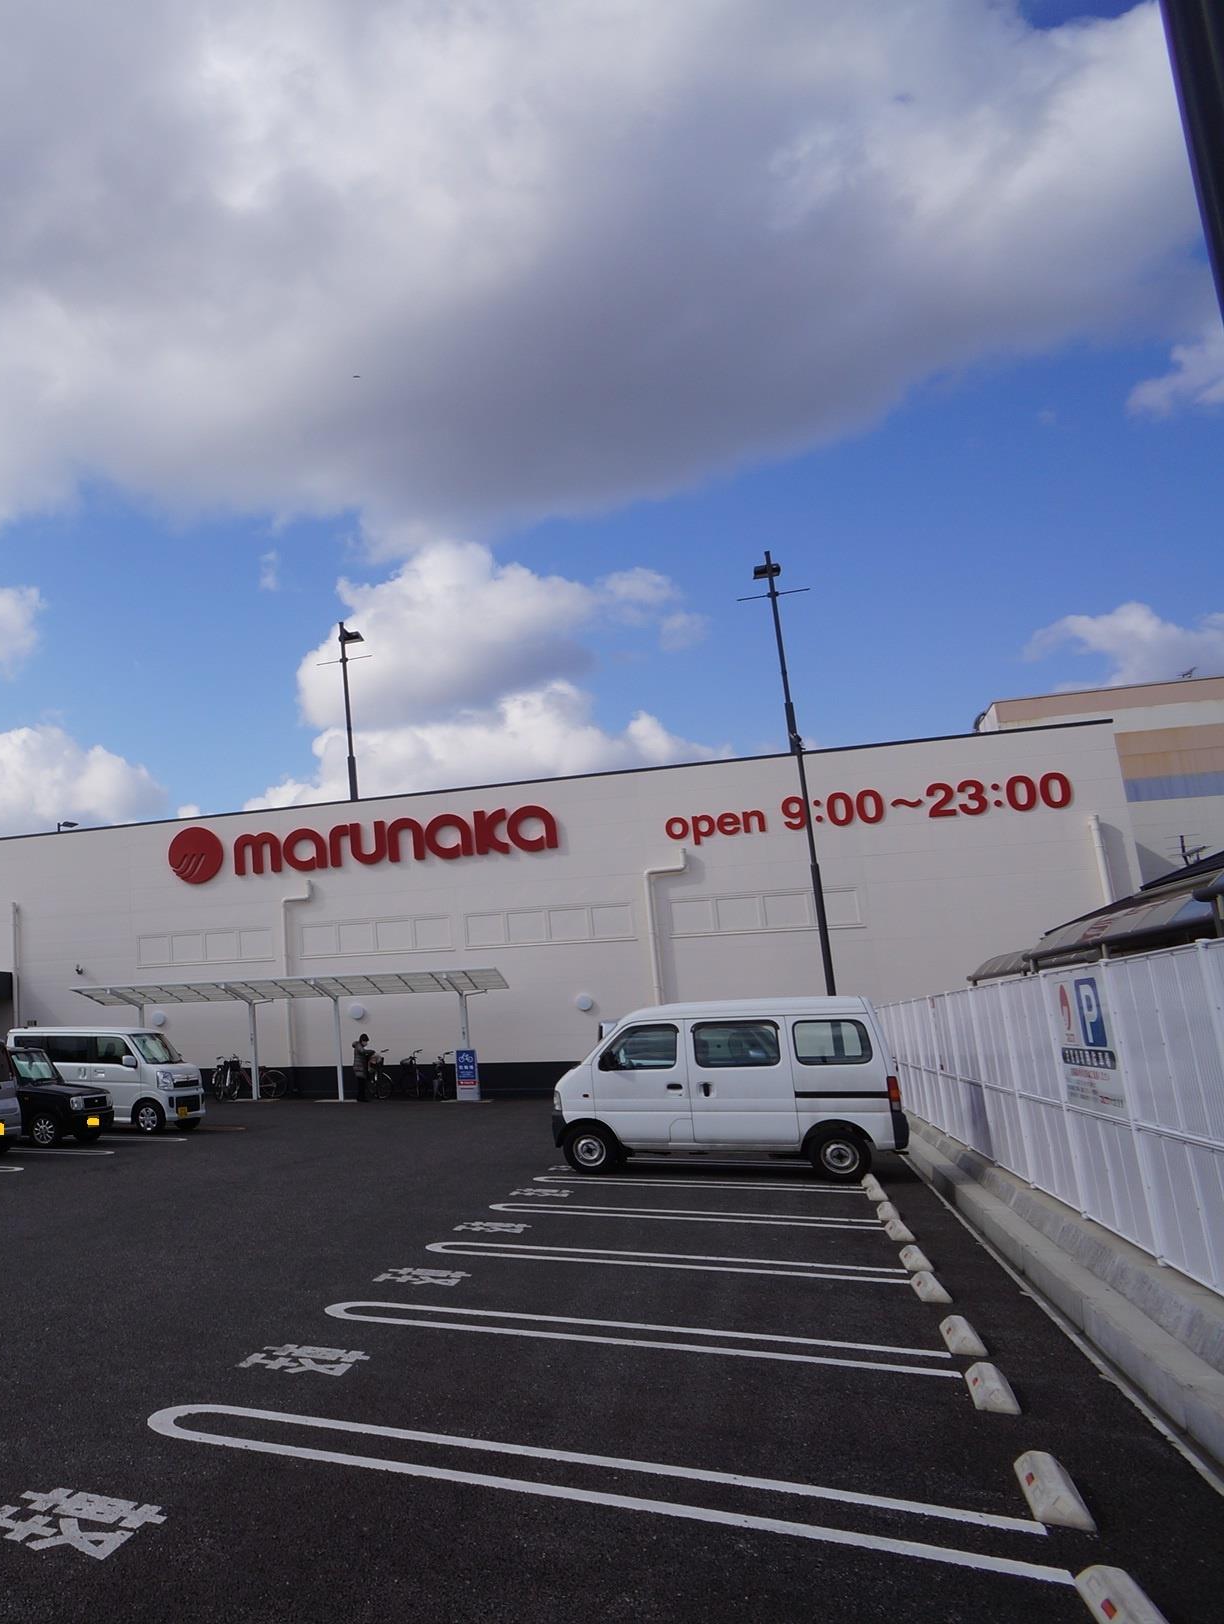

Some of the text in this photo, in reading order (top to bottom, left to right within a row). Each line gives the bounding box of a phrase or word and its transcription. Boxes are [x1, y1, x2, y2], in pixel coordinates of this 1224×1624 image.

[234, 804, 559, 876] marunaka
[665, 811, 766, 844] open
[1079, 984, 1098, 1042] P
[237, 1344, 371, 1376] 軽
